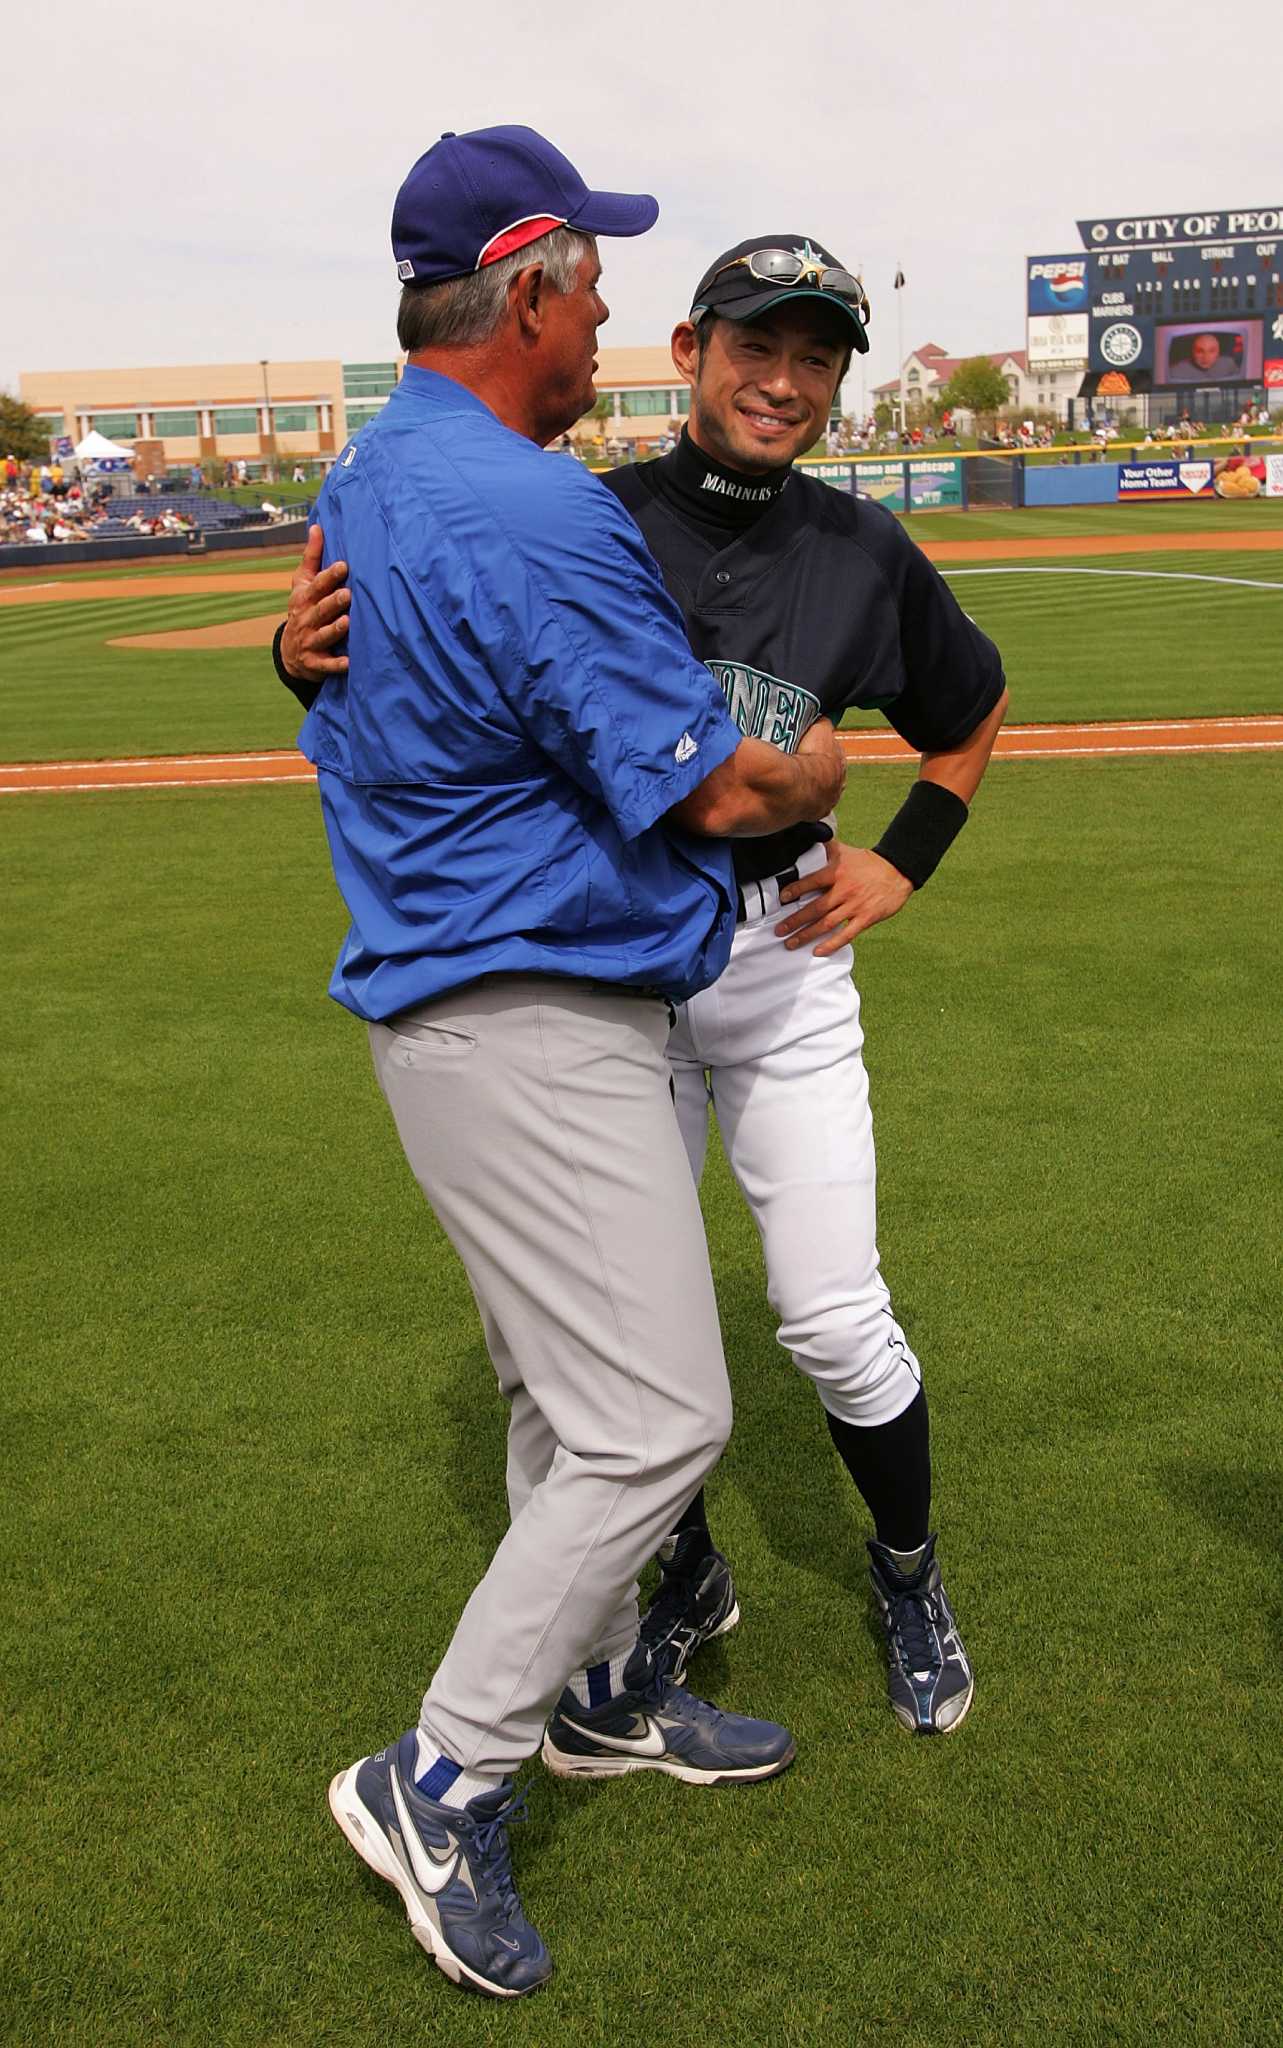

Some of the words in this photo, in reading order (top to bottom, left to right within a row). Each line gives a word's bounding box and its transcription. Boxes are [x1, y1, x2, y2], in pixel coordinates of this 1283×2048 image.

[1115, 218, 1179, 241] CITY
[1183, 215, 1220, 236] OF
[1201, 246, 1235, 260] STRIKE
[1256, 243, 1277, 256] OUT
[1098, 254, 1110, 267] AT
[1112, 253, 1130, 265] BAT
[1151, 250, 1175, 263] BALL
[1030, 261, 1086, 280] PEPSI
[1136, 282, 1142, 292] 1
[1145, 281, 1152, 292] 2
[1156, 280, 1162, 291] 3
[1173, 279, 1180, 289] 4
[1211, 277, 1218, 288] 7
[909, 461, 955, 473] andscape
[1123, 468, 1145, 478] Your
[1145, 467, 1173, 477] Other
[1120, 479, 1149, 489] Home
[1149, 476, 1178, 488] Team!
